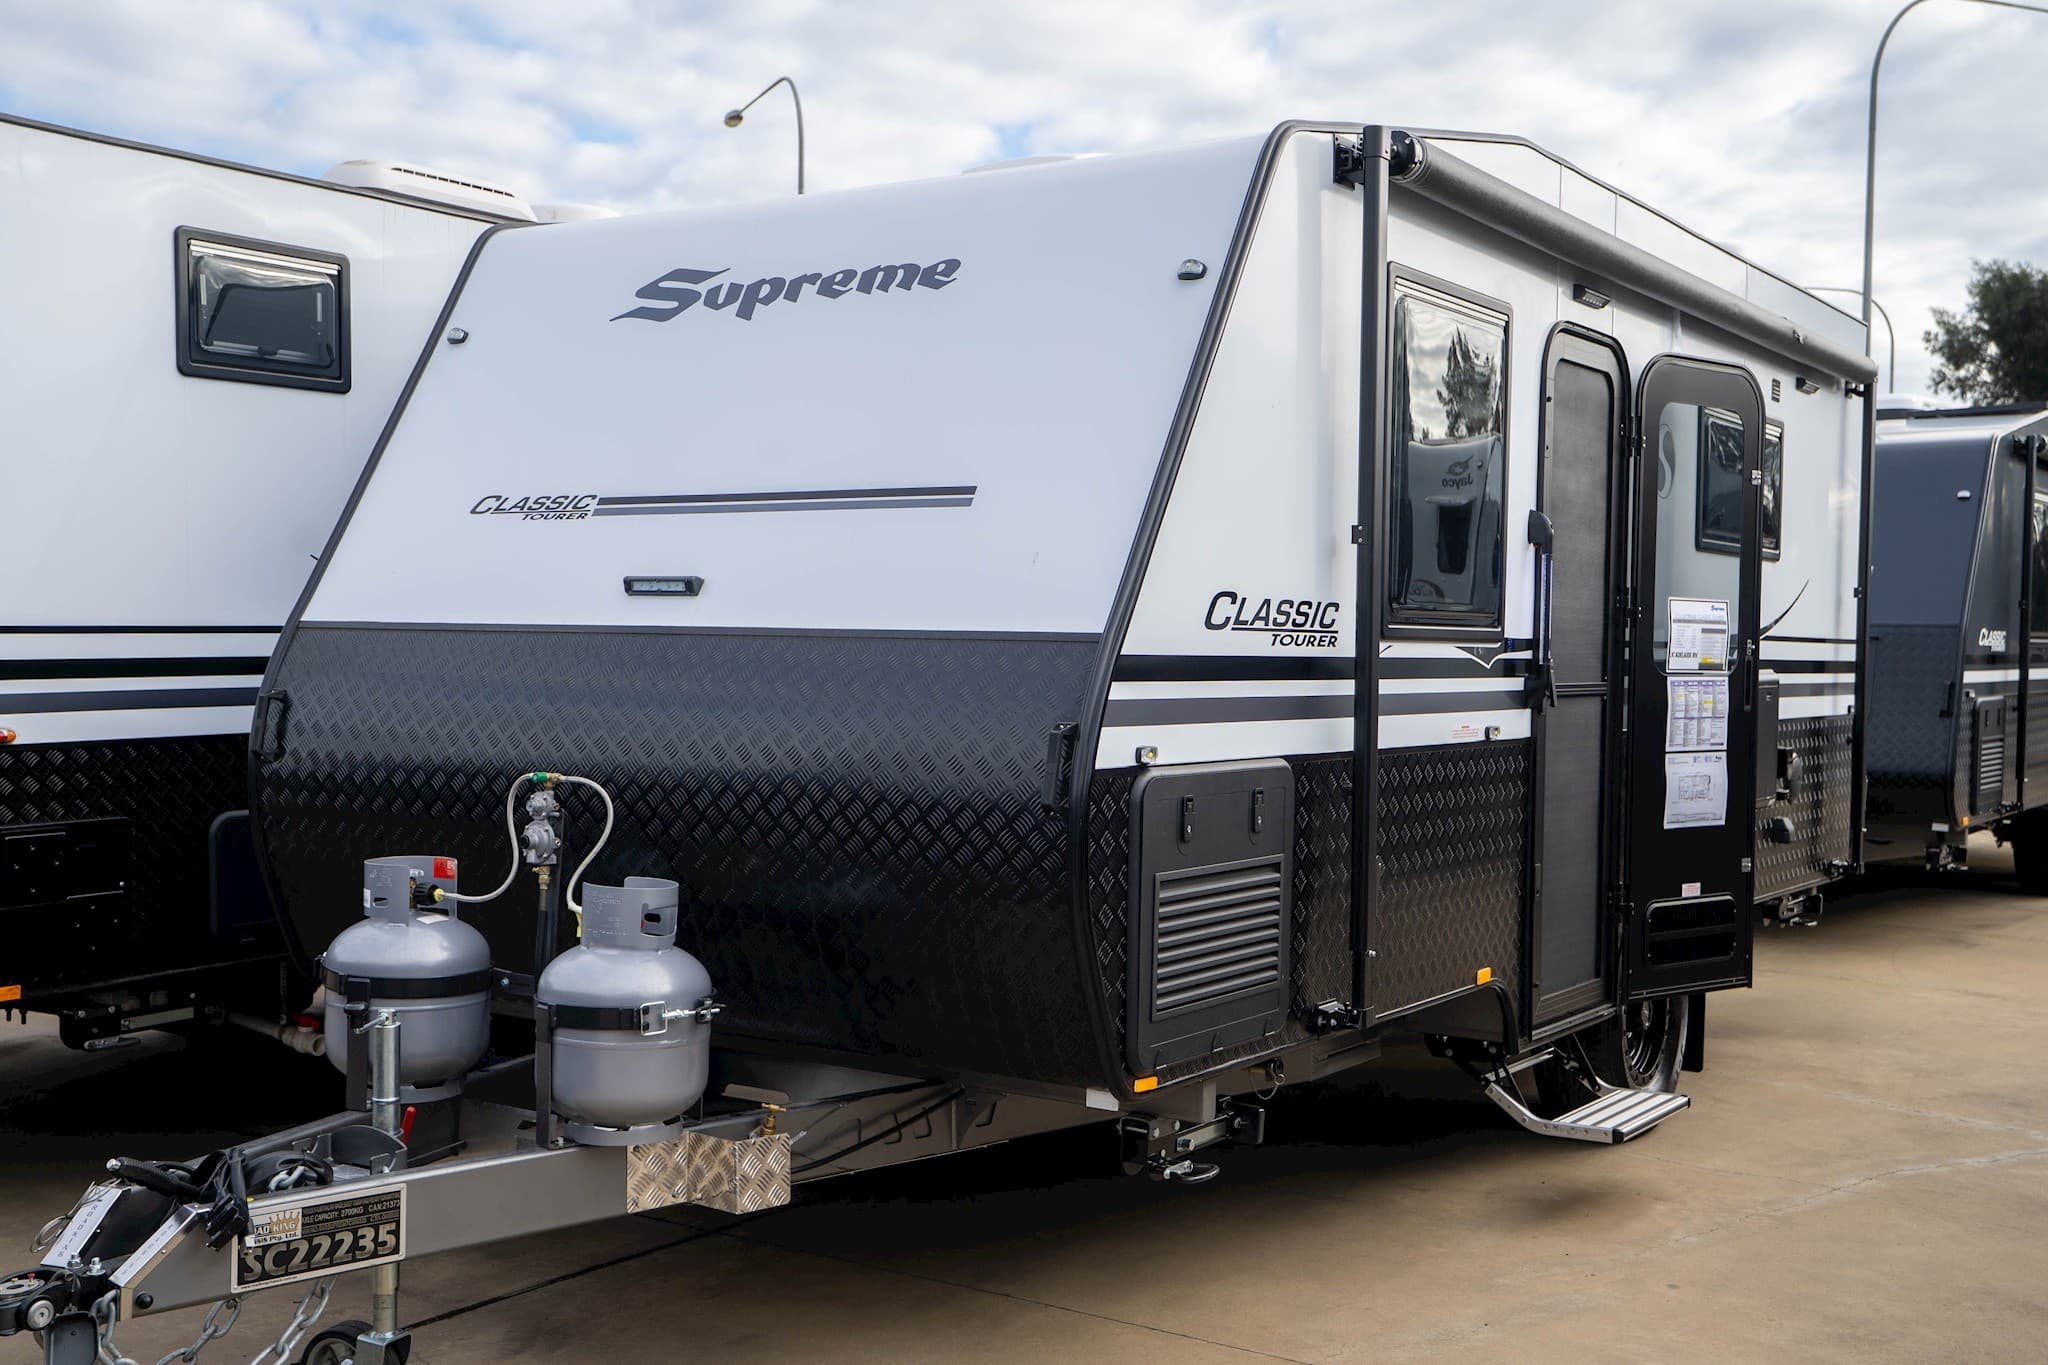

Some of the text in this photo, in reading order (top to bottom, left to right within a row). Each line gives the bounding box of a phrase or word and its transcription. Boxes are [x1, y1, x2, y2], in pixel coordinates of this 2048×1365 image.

[609, 258, 962, 322] Supreme
[470, 494, 598, 515] CLASSIC
[521, 512, 589, 521] TOURER
[1204, 591, 1340, 631] CLASSIC
[1271, 633, 1338, 648] TOURER
[1978, 627, 2007, 646] CLASSIC
[340, 1206, 364, 1217] 2700KG
[273, 1221, 297, 1233] KING
[241, 1222, 398, 1281] SC22235
